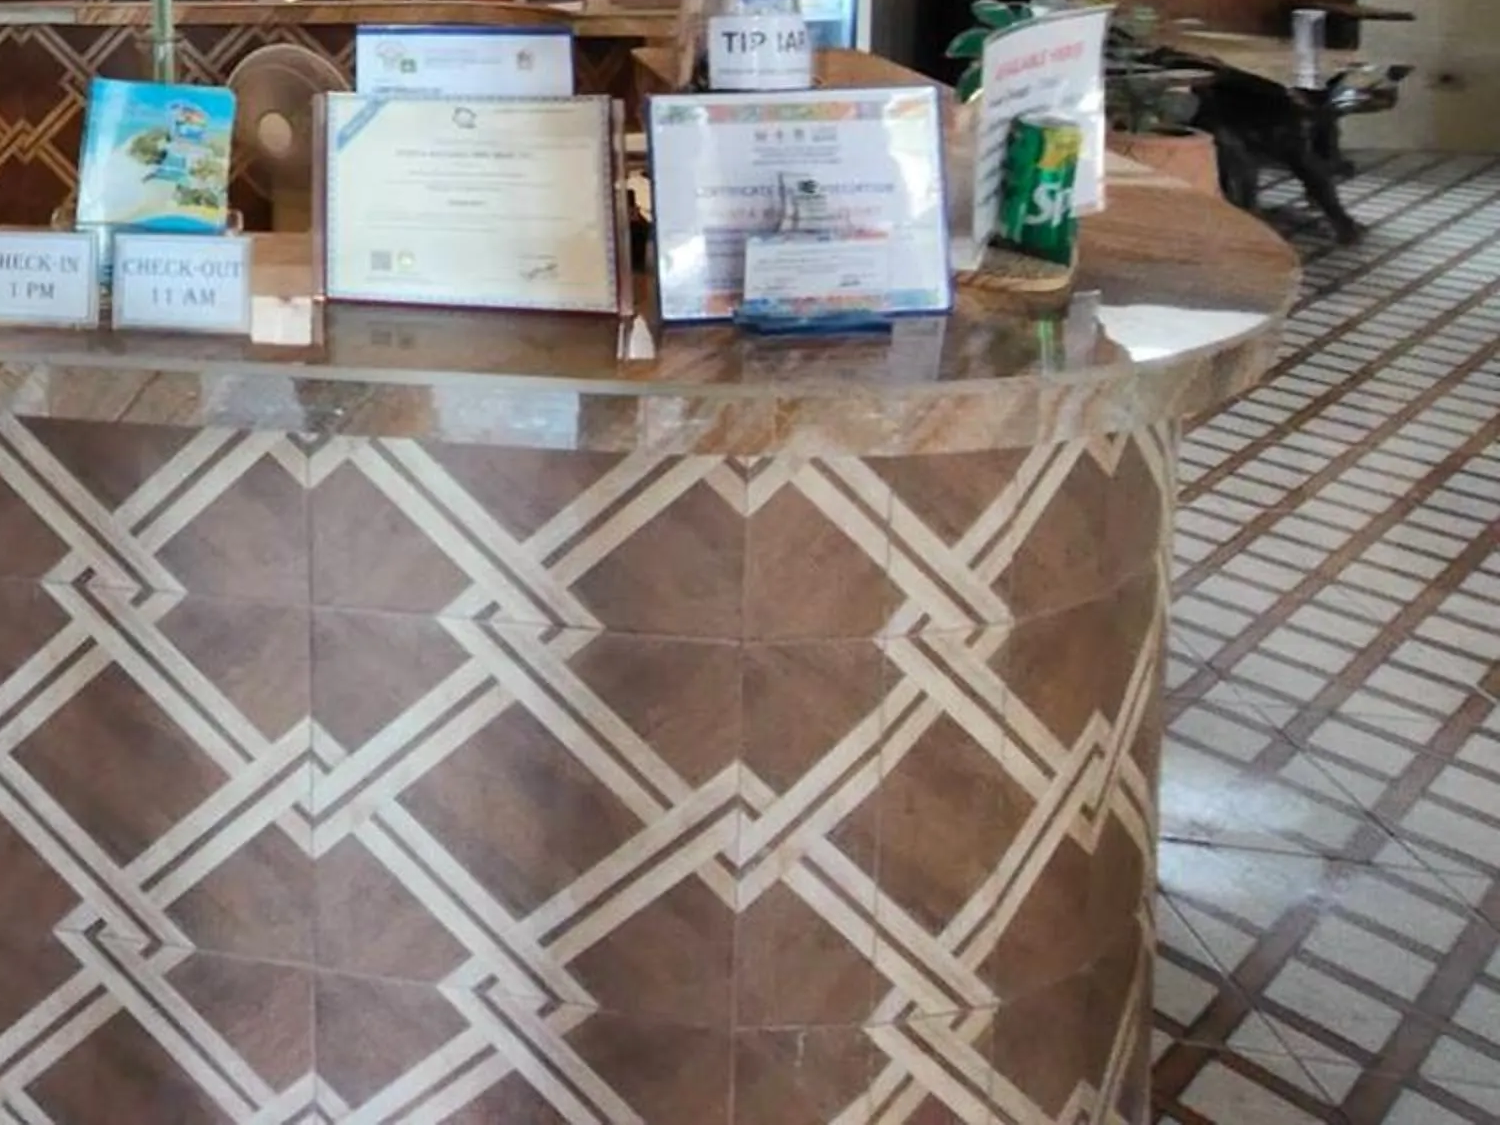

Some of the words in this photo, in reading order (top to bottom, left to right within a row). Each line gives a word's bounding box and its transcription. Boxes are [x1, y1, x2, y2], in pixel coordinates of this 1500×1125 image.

[721, 30, 767, 53] TIP
[121, 258, 245, 278] CHECK-OUT
[9, 282, 17, 298] 1
[26, 282, 55, 299] PM
[152, 288, 173, 305] 11
[182, 289, 216, 306] AM
